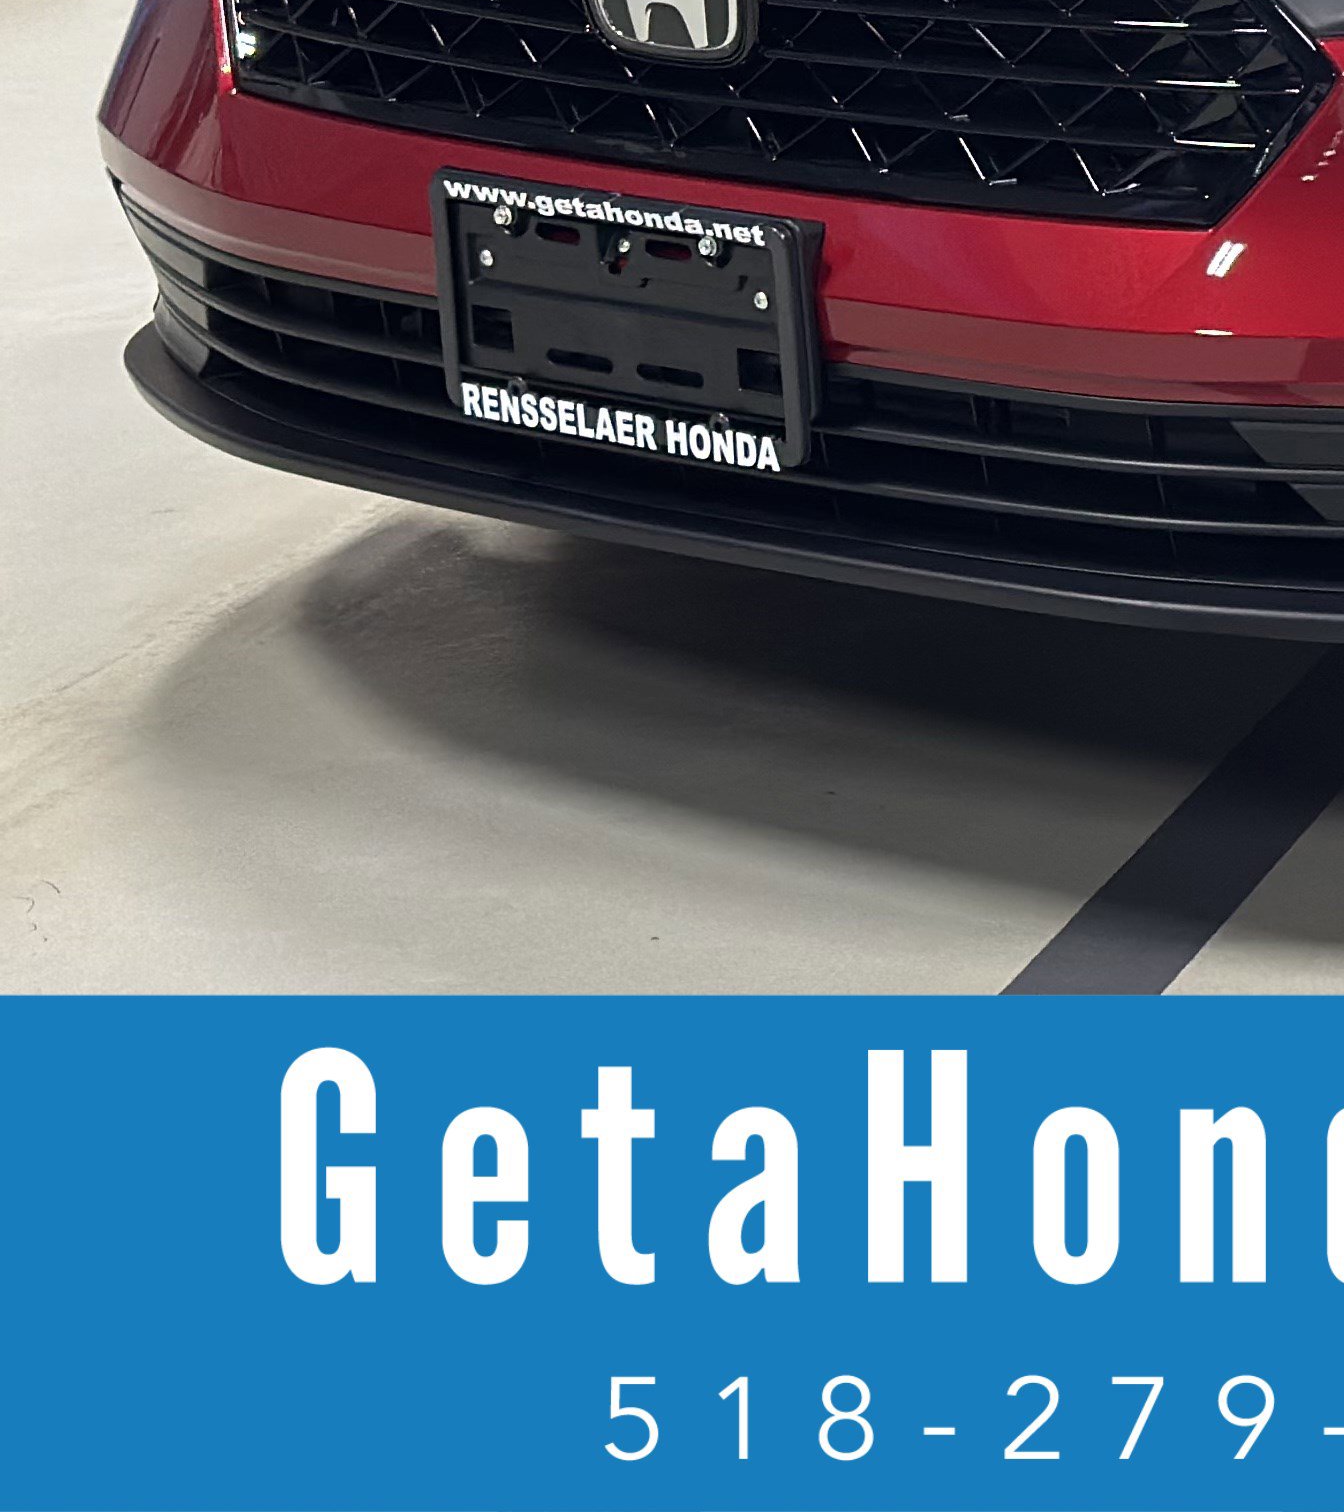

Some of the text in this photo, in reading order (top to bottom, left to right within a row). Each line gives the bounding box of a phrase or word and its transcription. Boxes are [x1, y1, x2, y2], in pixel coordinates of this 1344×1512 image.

[443, 179, 767, 246] www.getahonda.net
[461, 382, 781, 472] RENSSELAER HONDA
